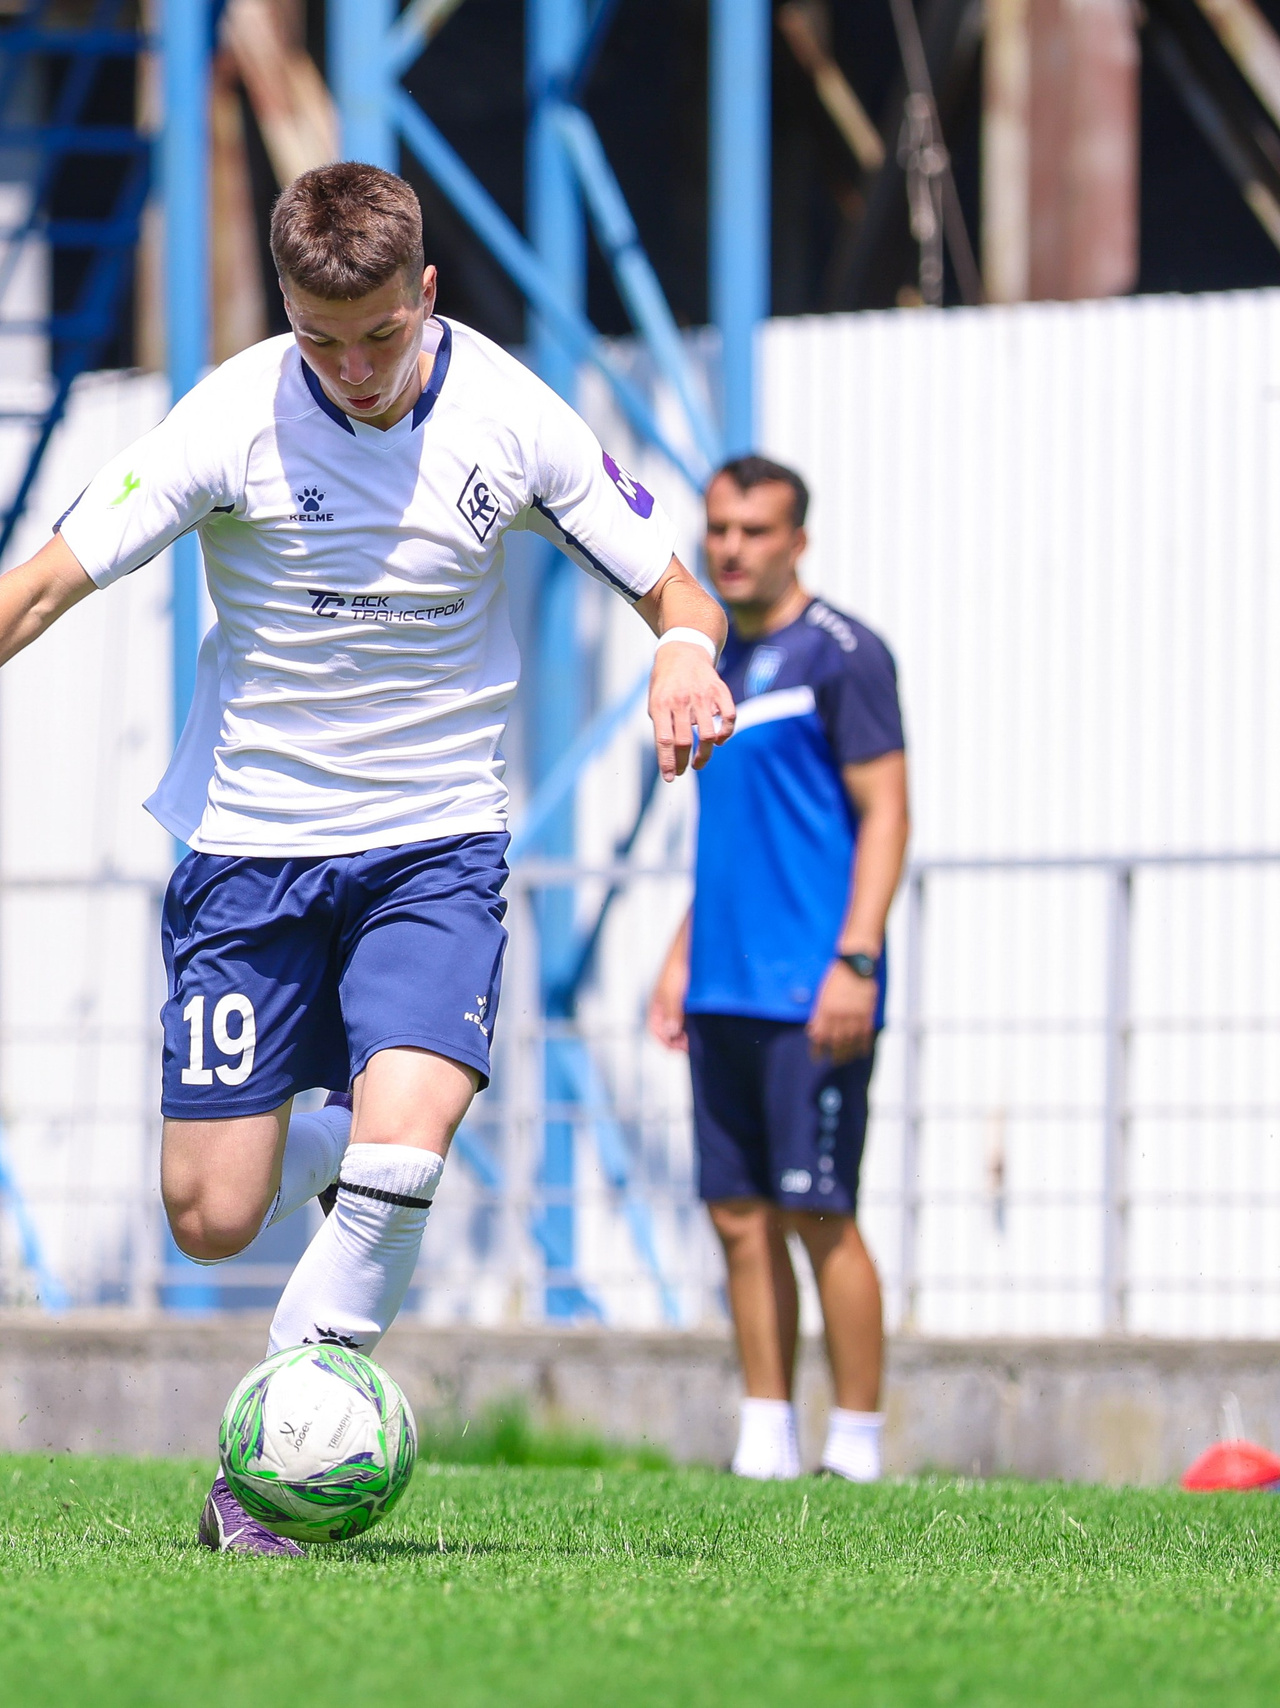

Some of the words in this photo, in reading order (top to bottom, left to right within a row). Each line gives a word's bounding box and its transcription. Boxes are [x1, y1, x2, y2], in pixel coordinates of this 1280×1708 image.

[289, 513, 334, 522] KELME
[351, 596, 389, 607] ДСК
[351, 598, 466, 622] ТРАНССТРОЙ
[181, 993, 256, 1086] 19
[327, 1413, 352, 1449] TRIUMPH
